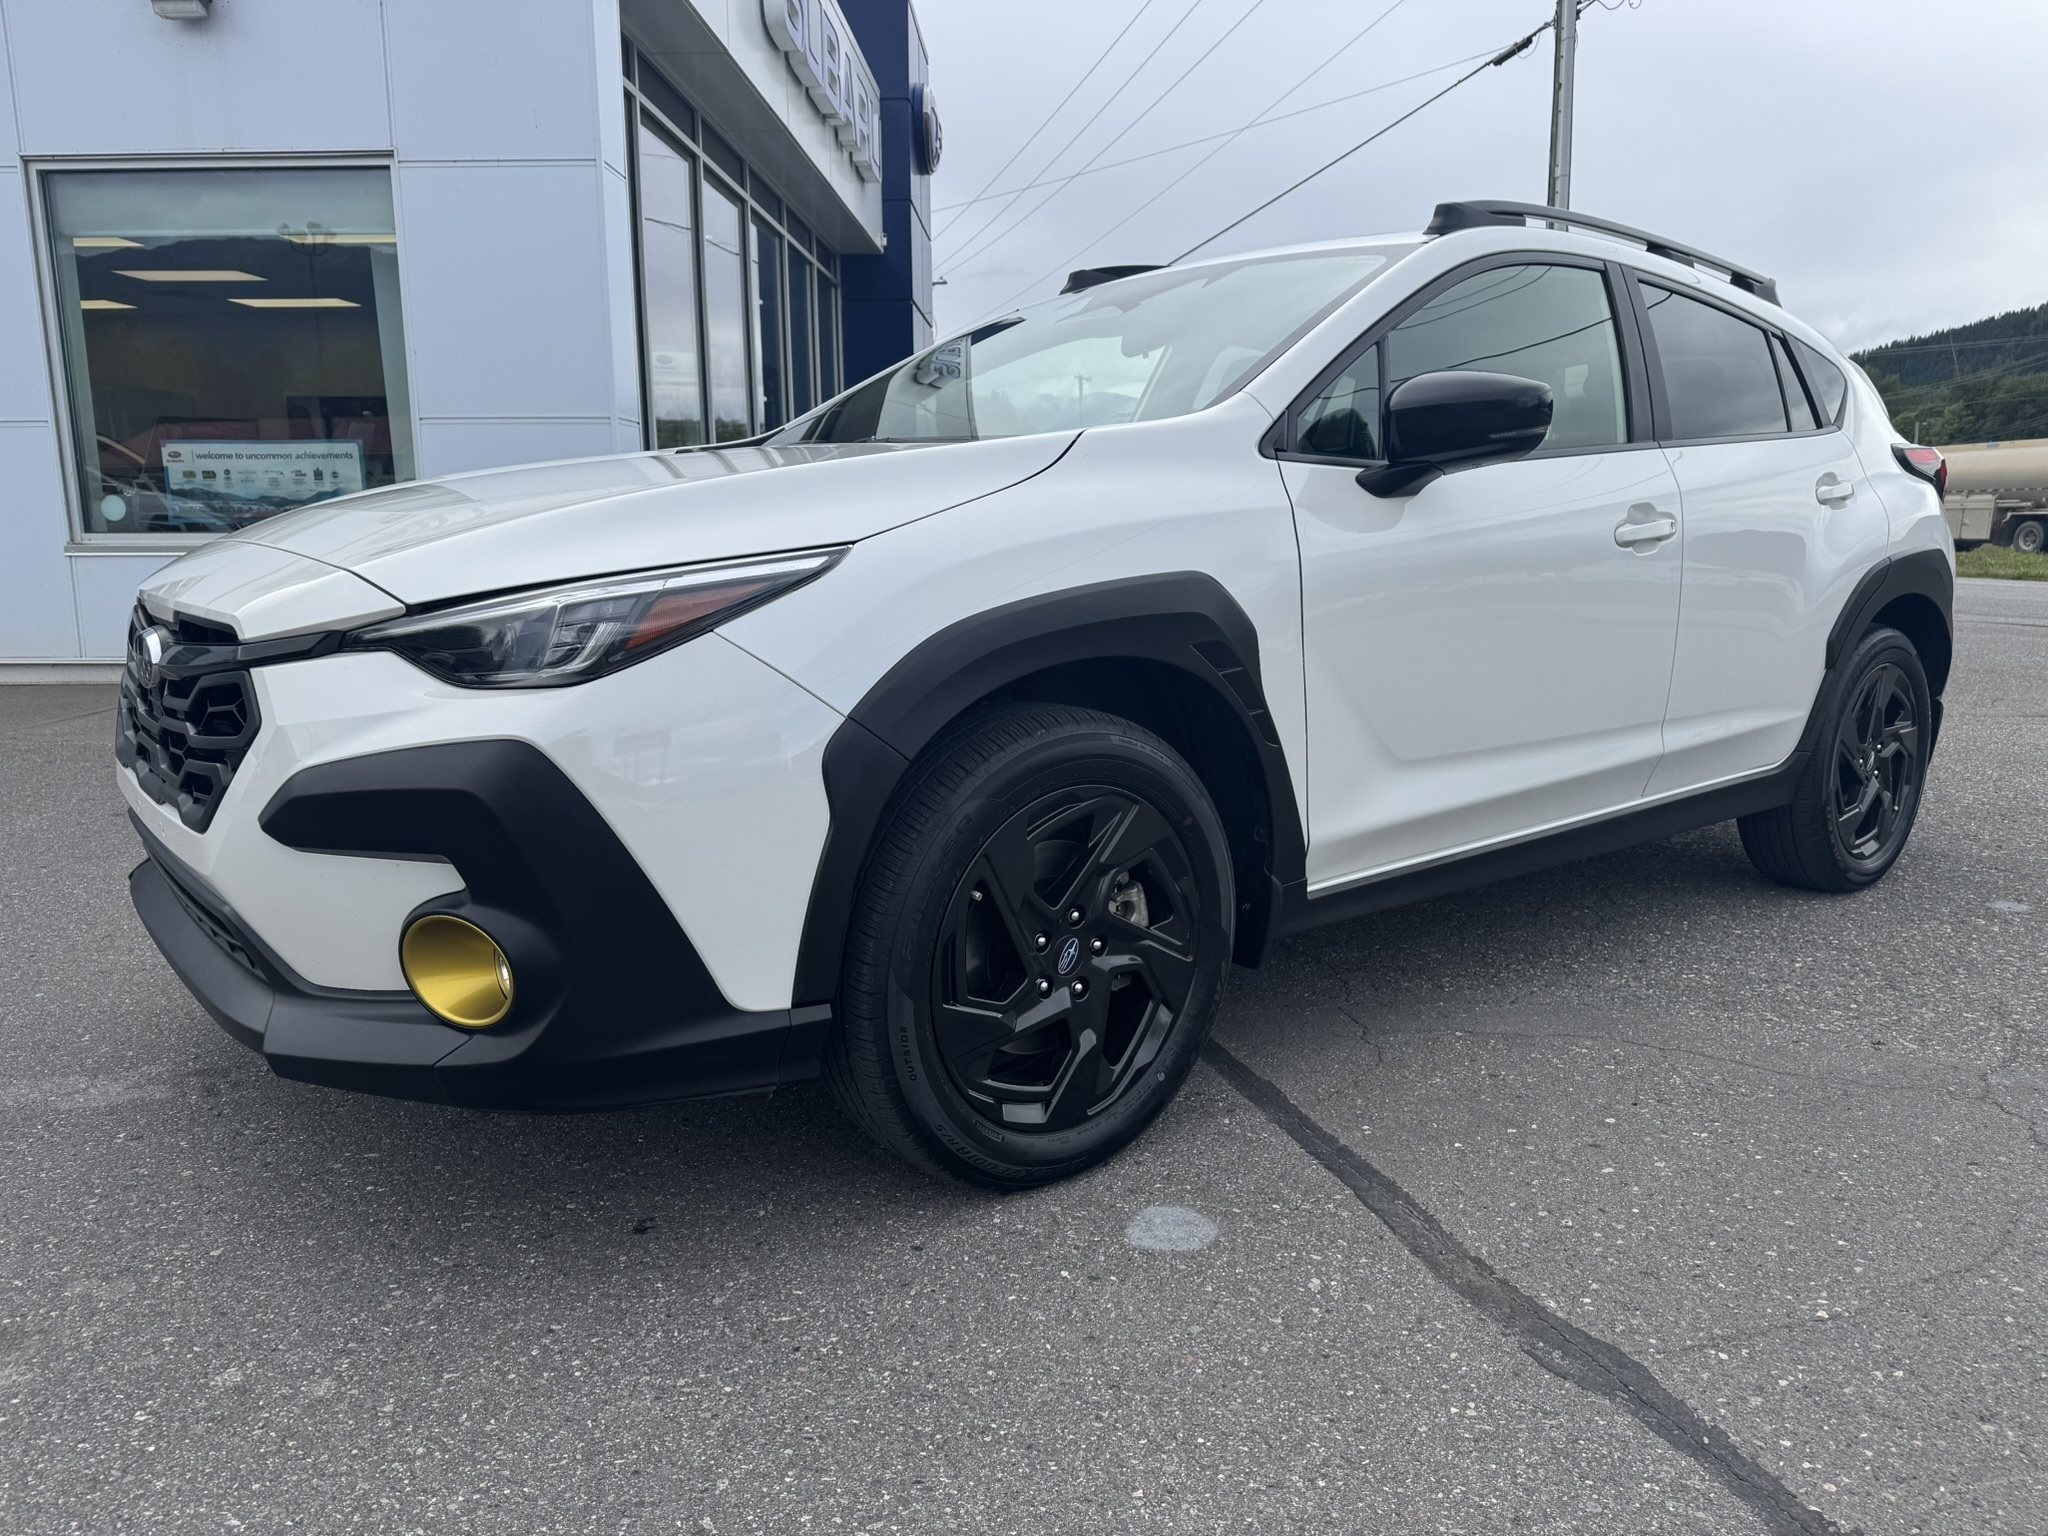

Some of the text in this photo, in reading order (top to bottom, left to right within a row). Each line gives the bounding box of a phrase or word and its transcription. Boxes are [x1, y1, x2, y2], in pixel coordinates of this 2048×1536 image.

[195, 450, 354, 460] welcome to uncommon achievements
[899, 1025, 918, 1082] OUTSIDE
[934, 1123, 959, 1146] A/S
